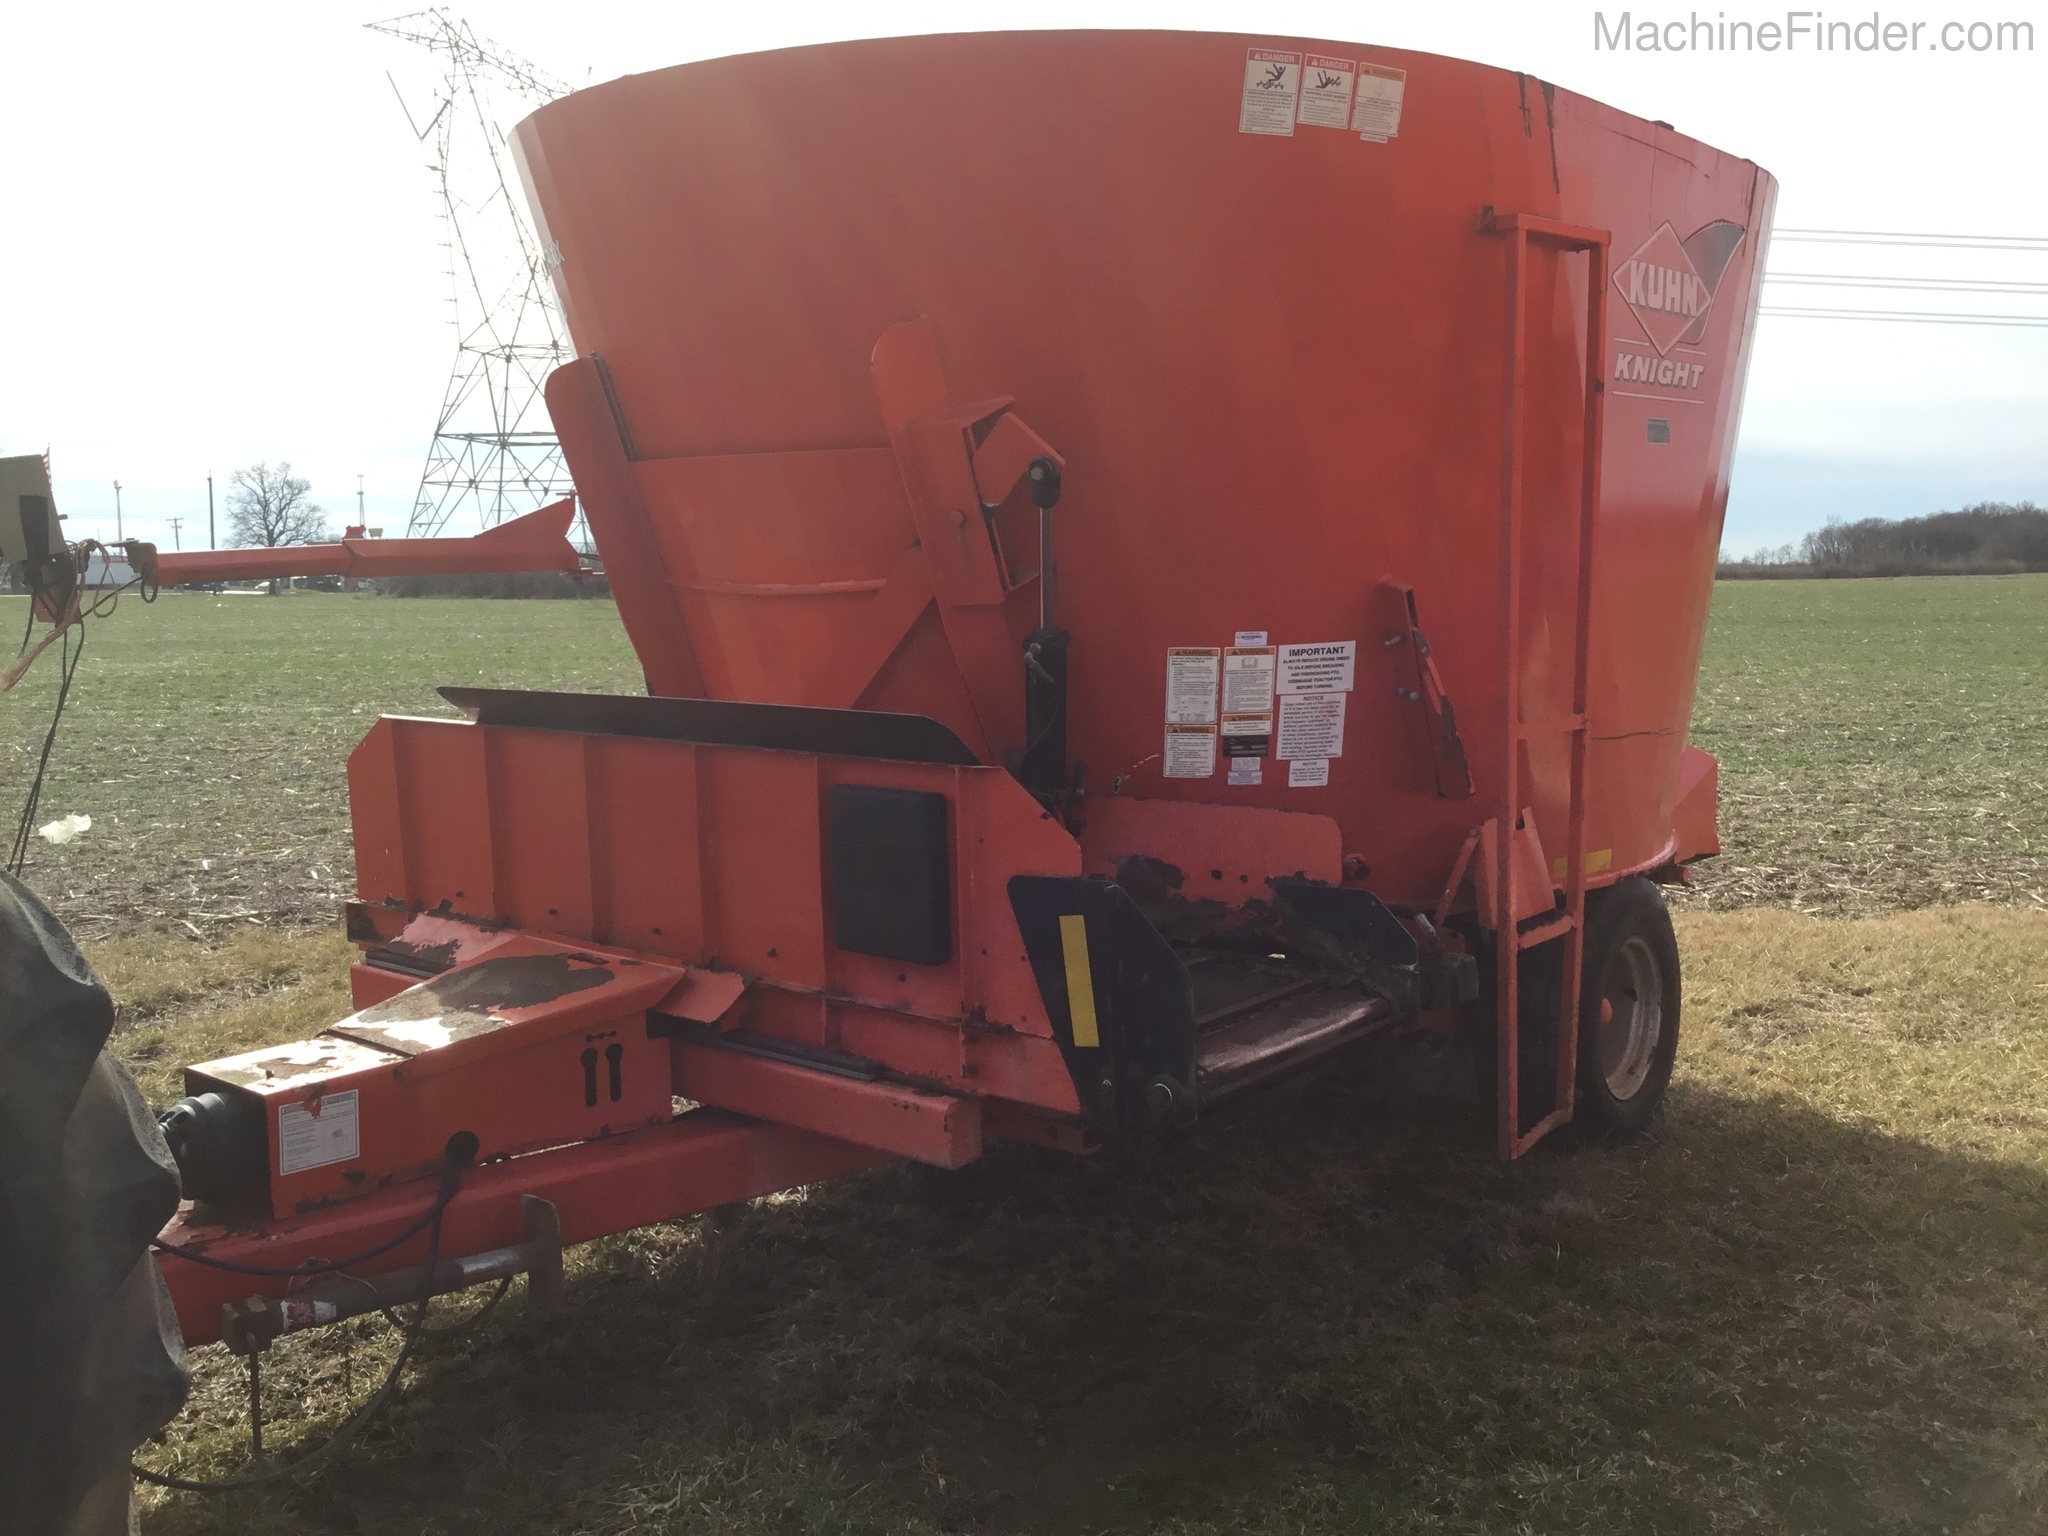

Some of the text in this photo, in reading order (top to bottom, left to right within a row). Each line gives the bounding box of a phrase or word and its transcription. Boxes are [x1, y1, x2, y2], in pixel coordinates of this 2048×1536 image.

[1262, 53, 1295, 63] DANGER
[1319, 59, 1349, 70] DANGER
[1371, 68, 1401, 79] WARNING
[1629, 259, 1699, 317] KUHN
[1614, 353, 1704, 388] KNIGHT
[1289, 646, 1345, 657] IMPORTANT
